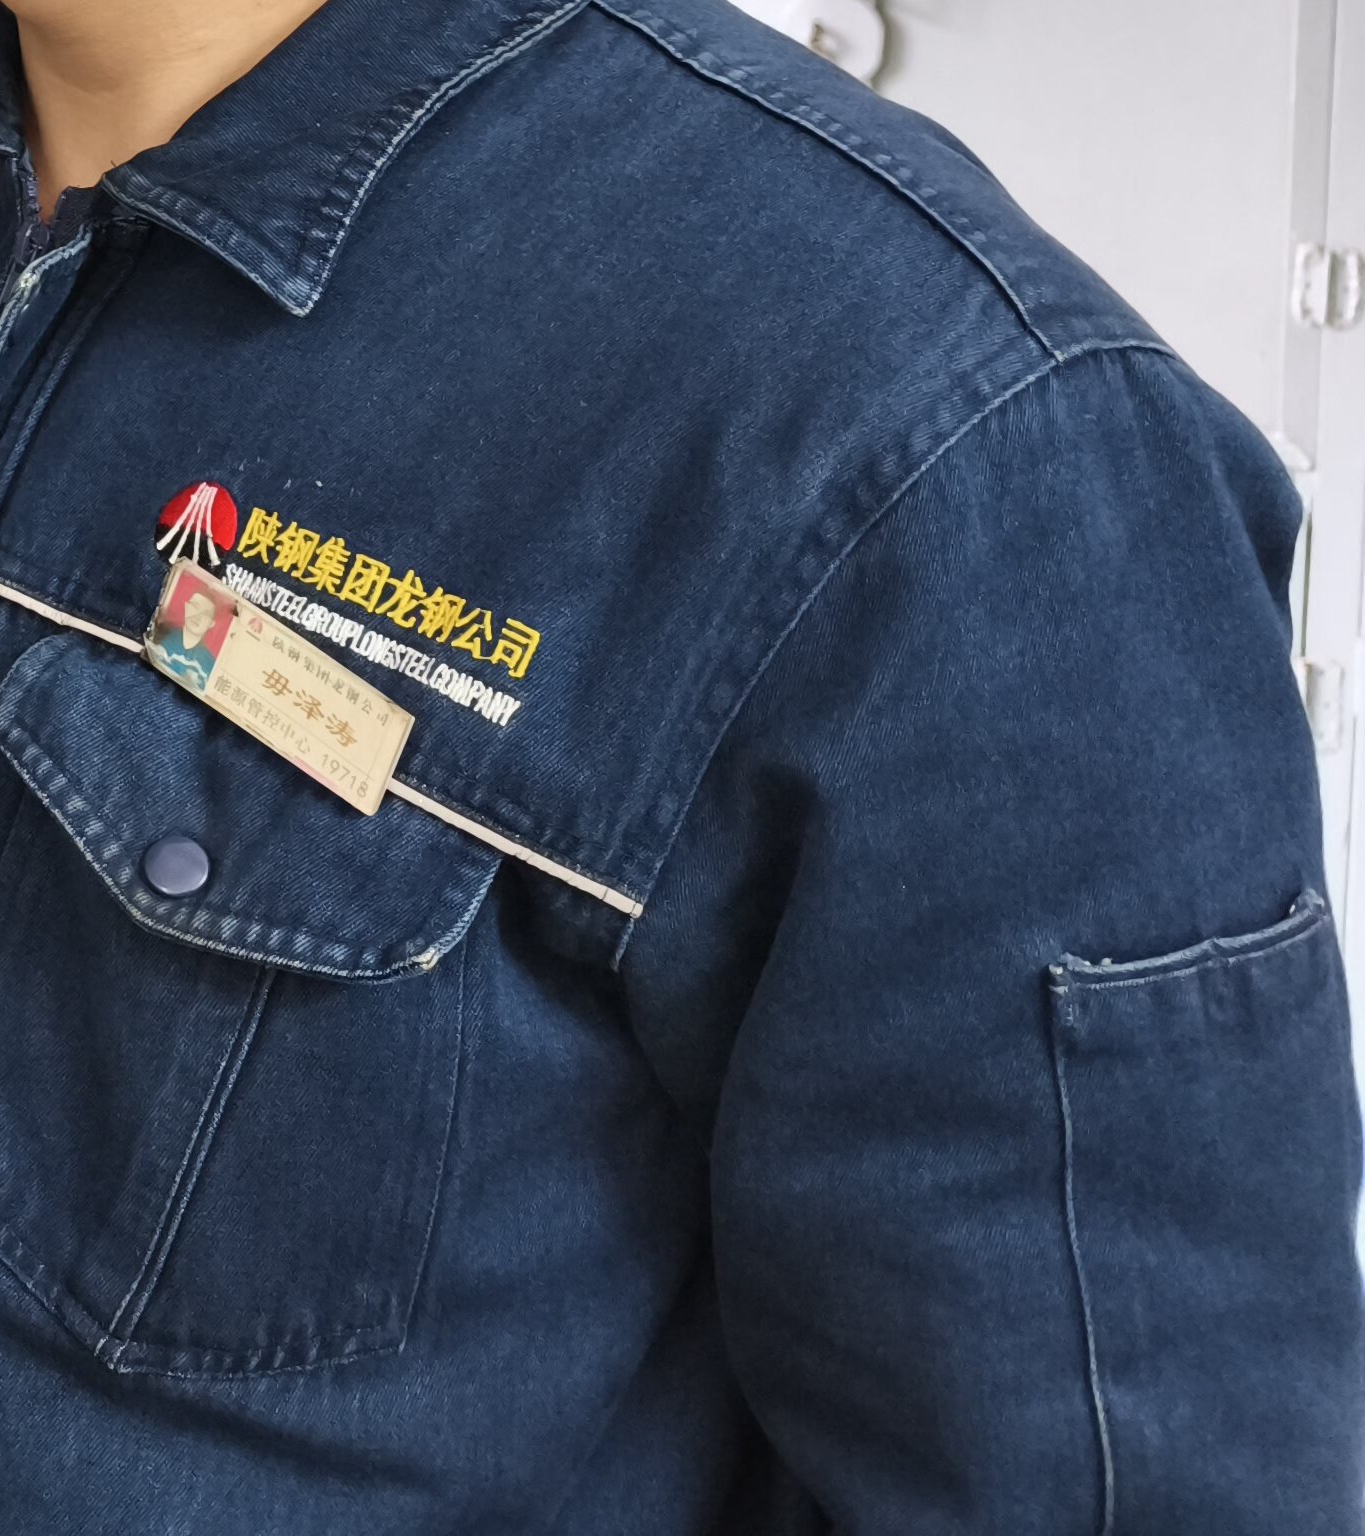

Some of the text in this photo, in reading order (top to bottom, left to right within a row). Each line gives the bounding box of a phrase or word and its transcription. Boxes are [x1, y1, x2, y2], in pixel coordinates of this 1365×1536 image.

[221, 562, 521, 727] SHAANSTEELGROUPLONGSTEELCOMPANY
[236, 506, 541, 678] 陕钢集团龙钢公司
[212, 674, 371, 800] 能源管控中心 19718
[260, 668, 358, 749] 毋泽涛
